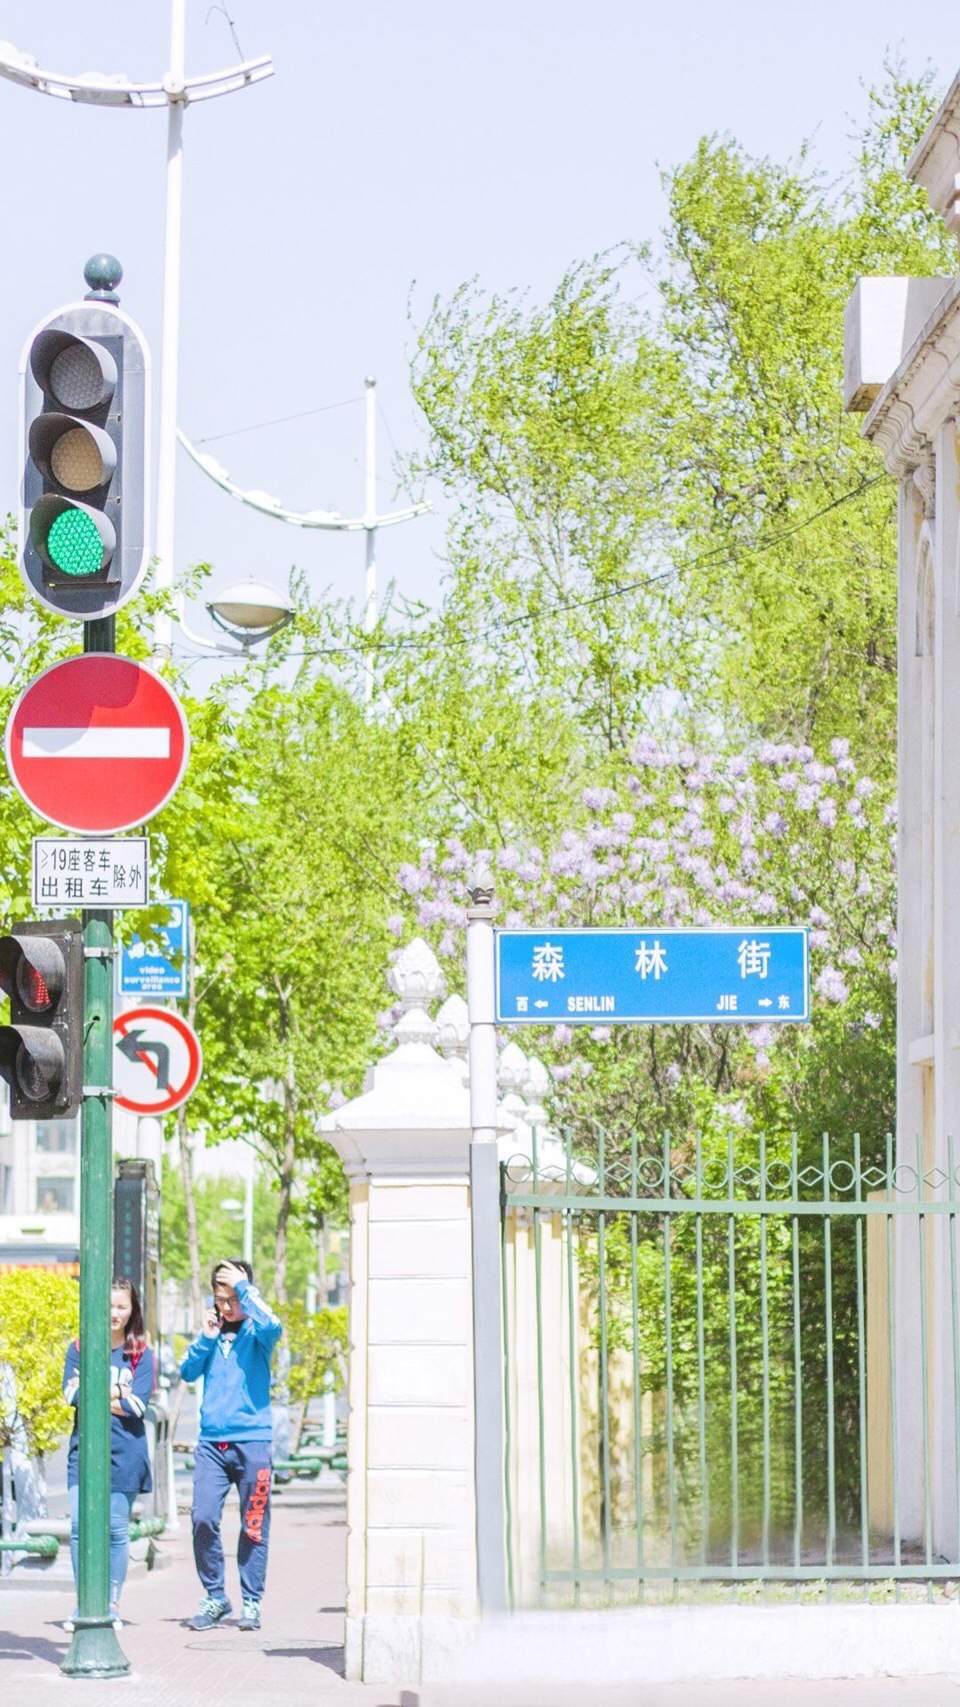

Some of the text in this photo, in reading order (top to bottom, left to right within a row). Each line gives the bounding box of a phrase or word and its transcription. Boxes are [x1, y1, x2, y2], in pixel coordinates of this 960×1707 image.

[113, 864, 142, 889] 除外
[42, 876, 109, 898] 出租车
[532, 940, 772, 982] 森林街
[138, 966, 165, 975] video
[124, 976, 181, 984] surveillance
[516, 996, 528, 1012] 西
[567, 994, 738, 1012] SENLIN JIE
[778, 994, 790, 1010] 东
